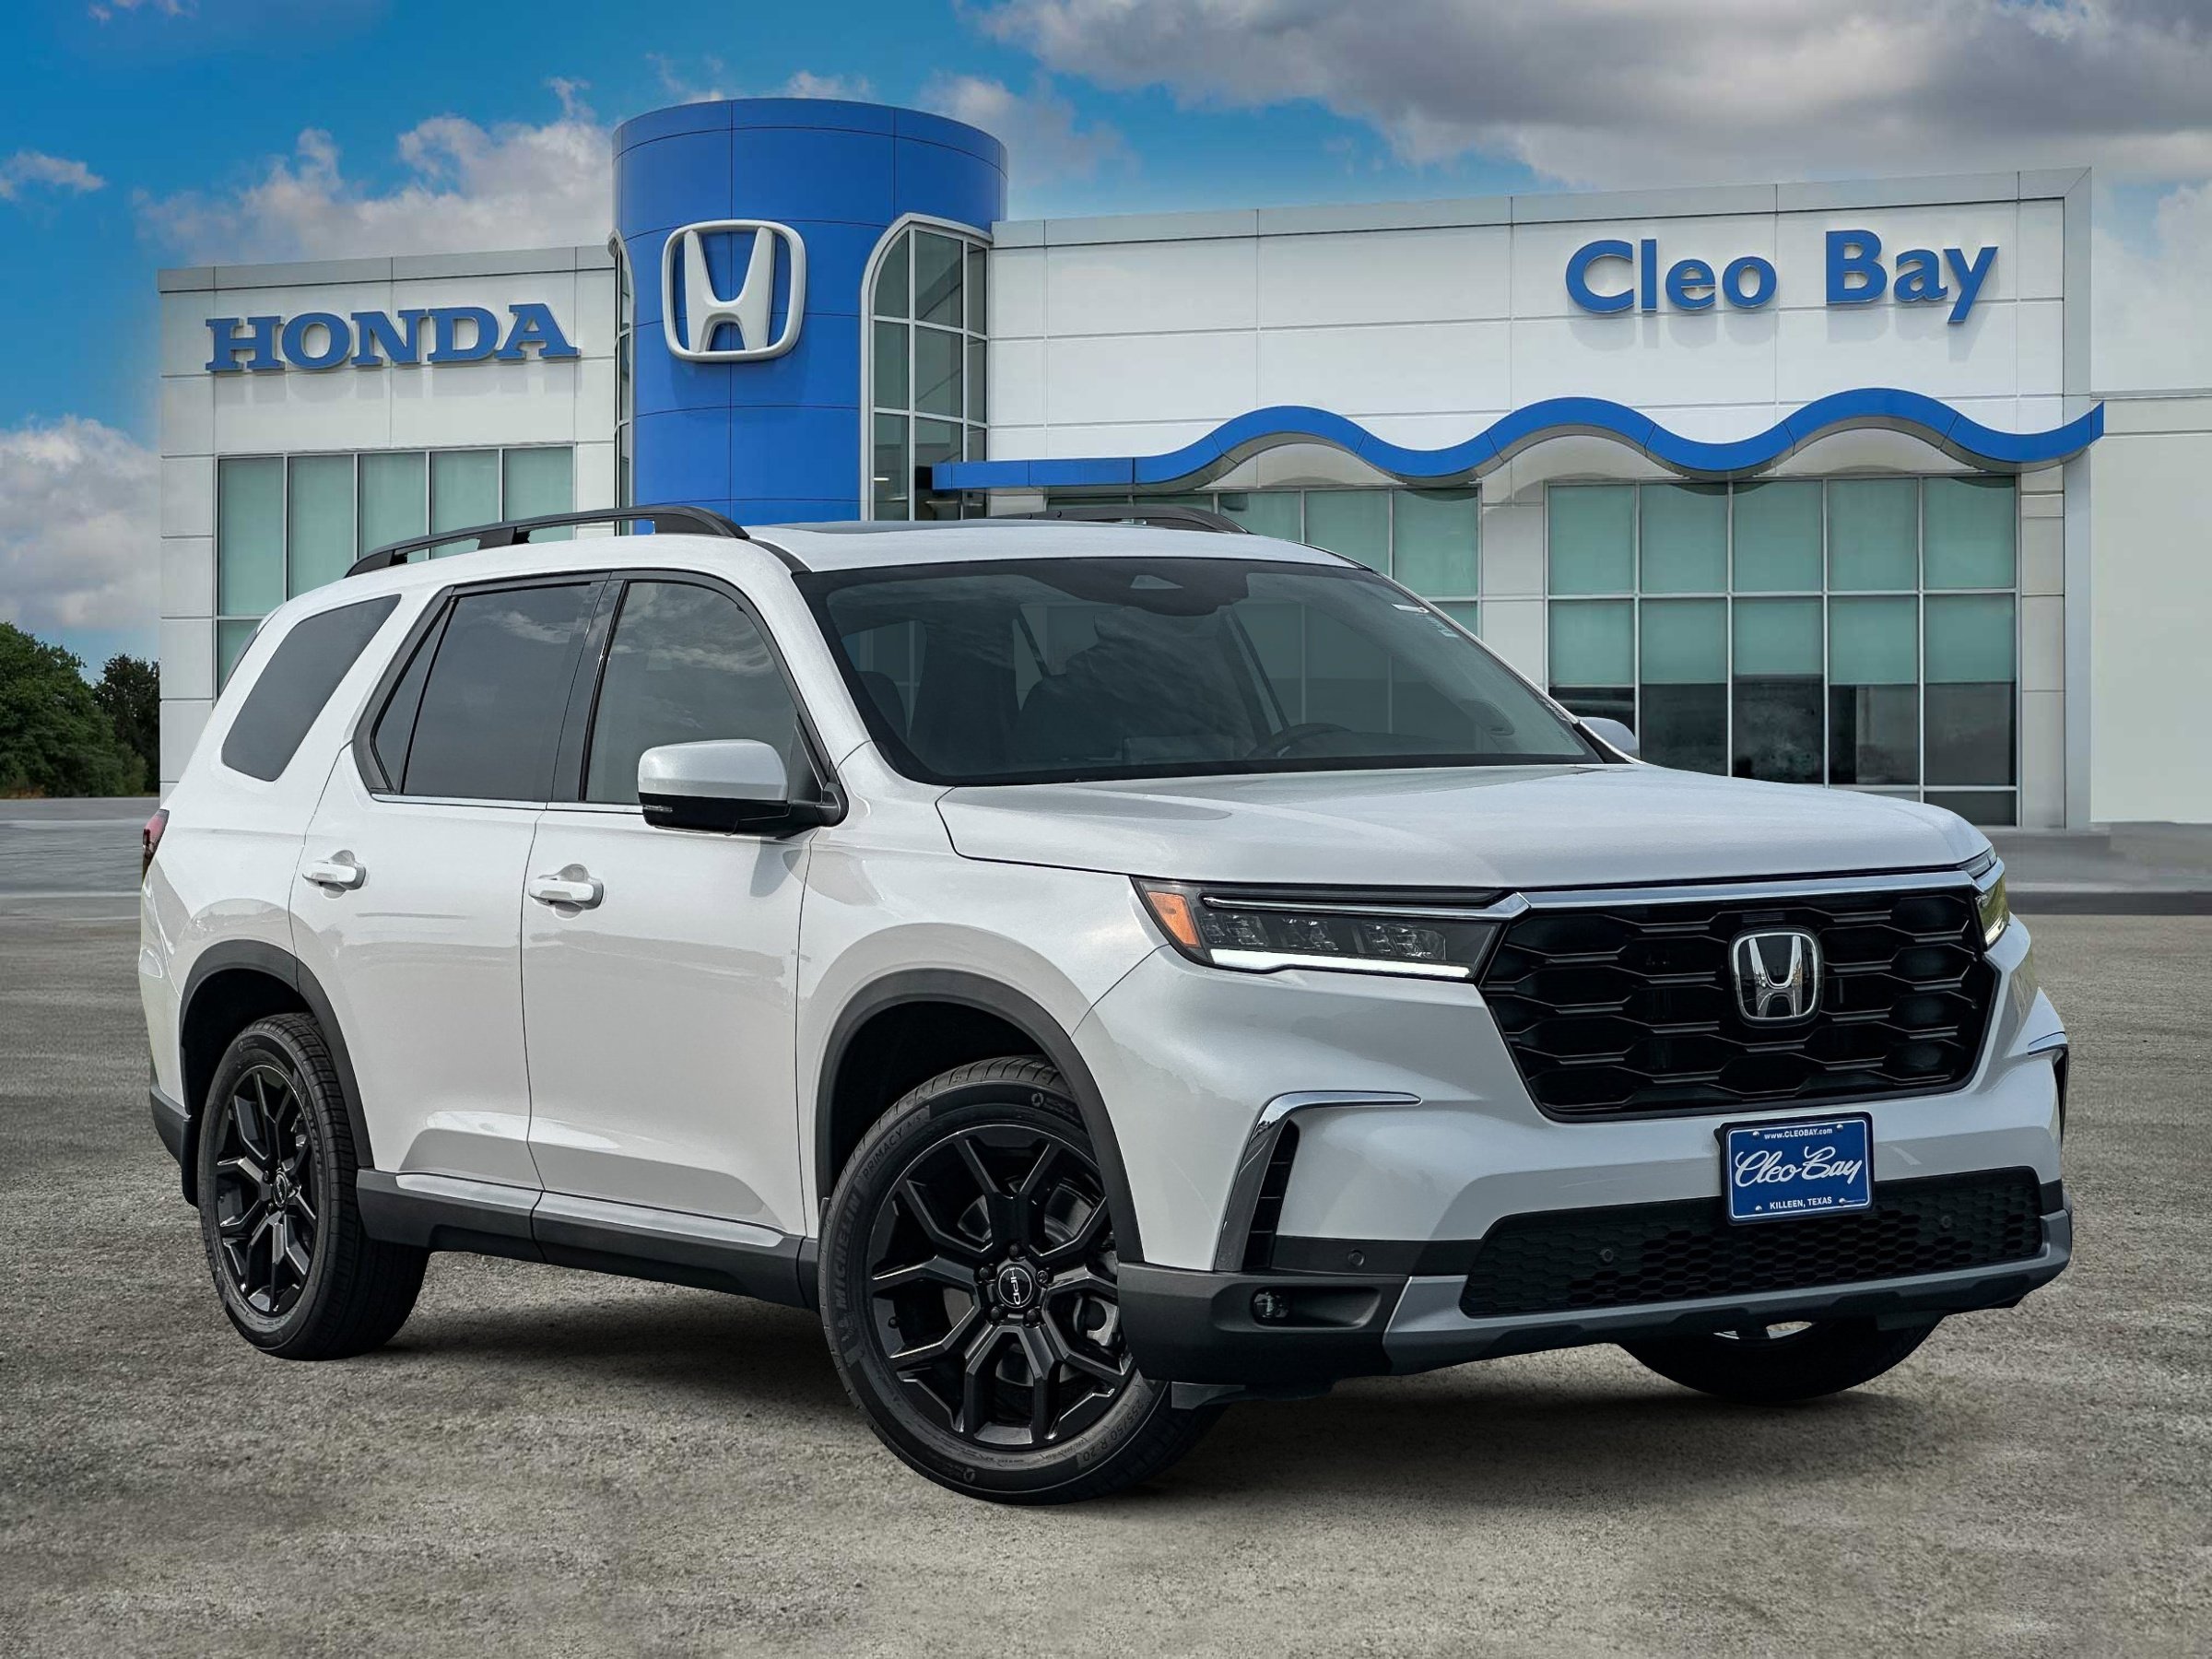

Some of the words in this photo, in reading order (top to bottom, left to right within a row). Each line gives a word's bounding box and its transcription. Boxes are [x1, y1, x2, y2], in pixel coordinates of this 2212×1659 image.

[1566, 239, 1777, 313] Cleo
[1825, 229, 1999, 324] Bay
[205, 303, 582, 372] HONDA
[862, 1127, 902, 1179] PRIMACY
[1764, 1128, 1833, 1140] www.CLEOBAY.com
[1735, 1150, 1800, 1187] Cleo
[1801, 1147, 1862, 1184] Bay
[1770, 1199, 1806, 1210] KILLEEN,
[1807, 1197, 1832, 1206] TEXAS
[836, 1193, 862, 1310] MICHELIN
[1110, 1399, 1143, 1441] 255/50
[1082, 1446, 1096, 1462] 20
